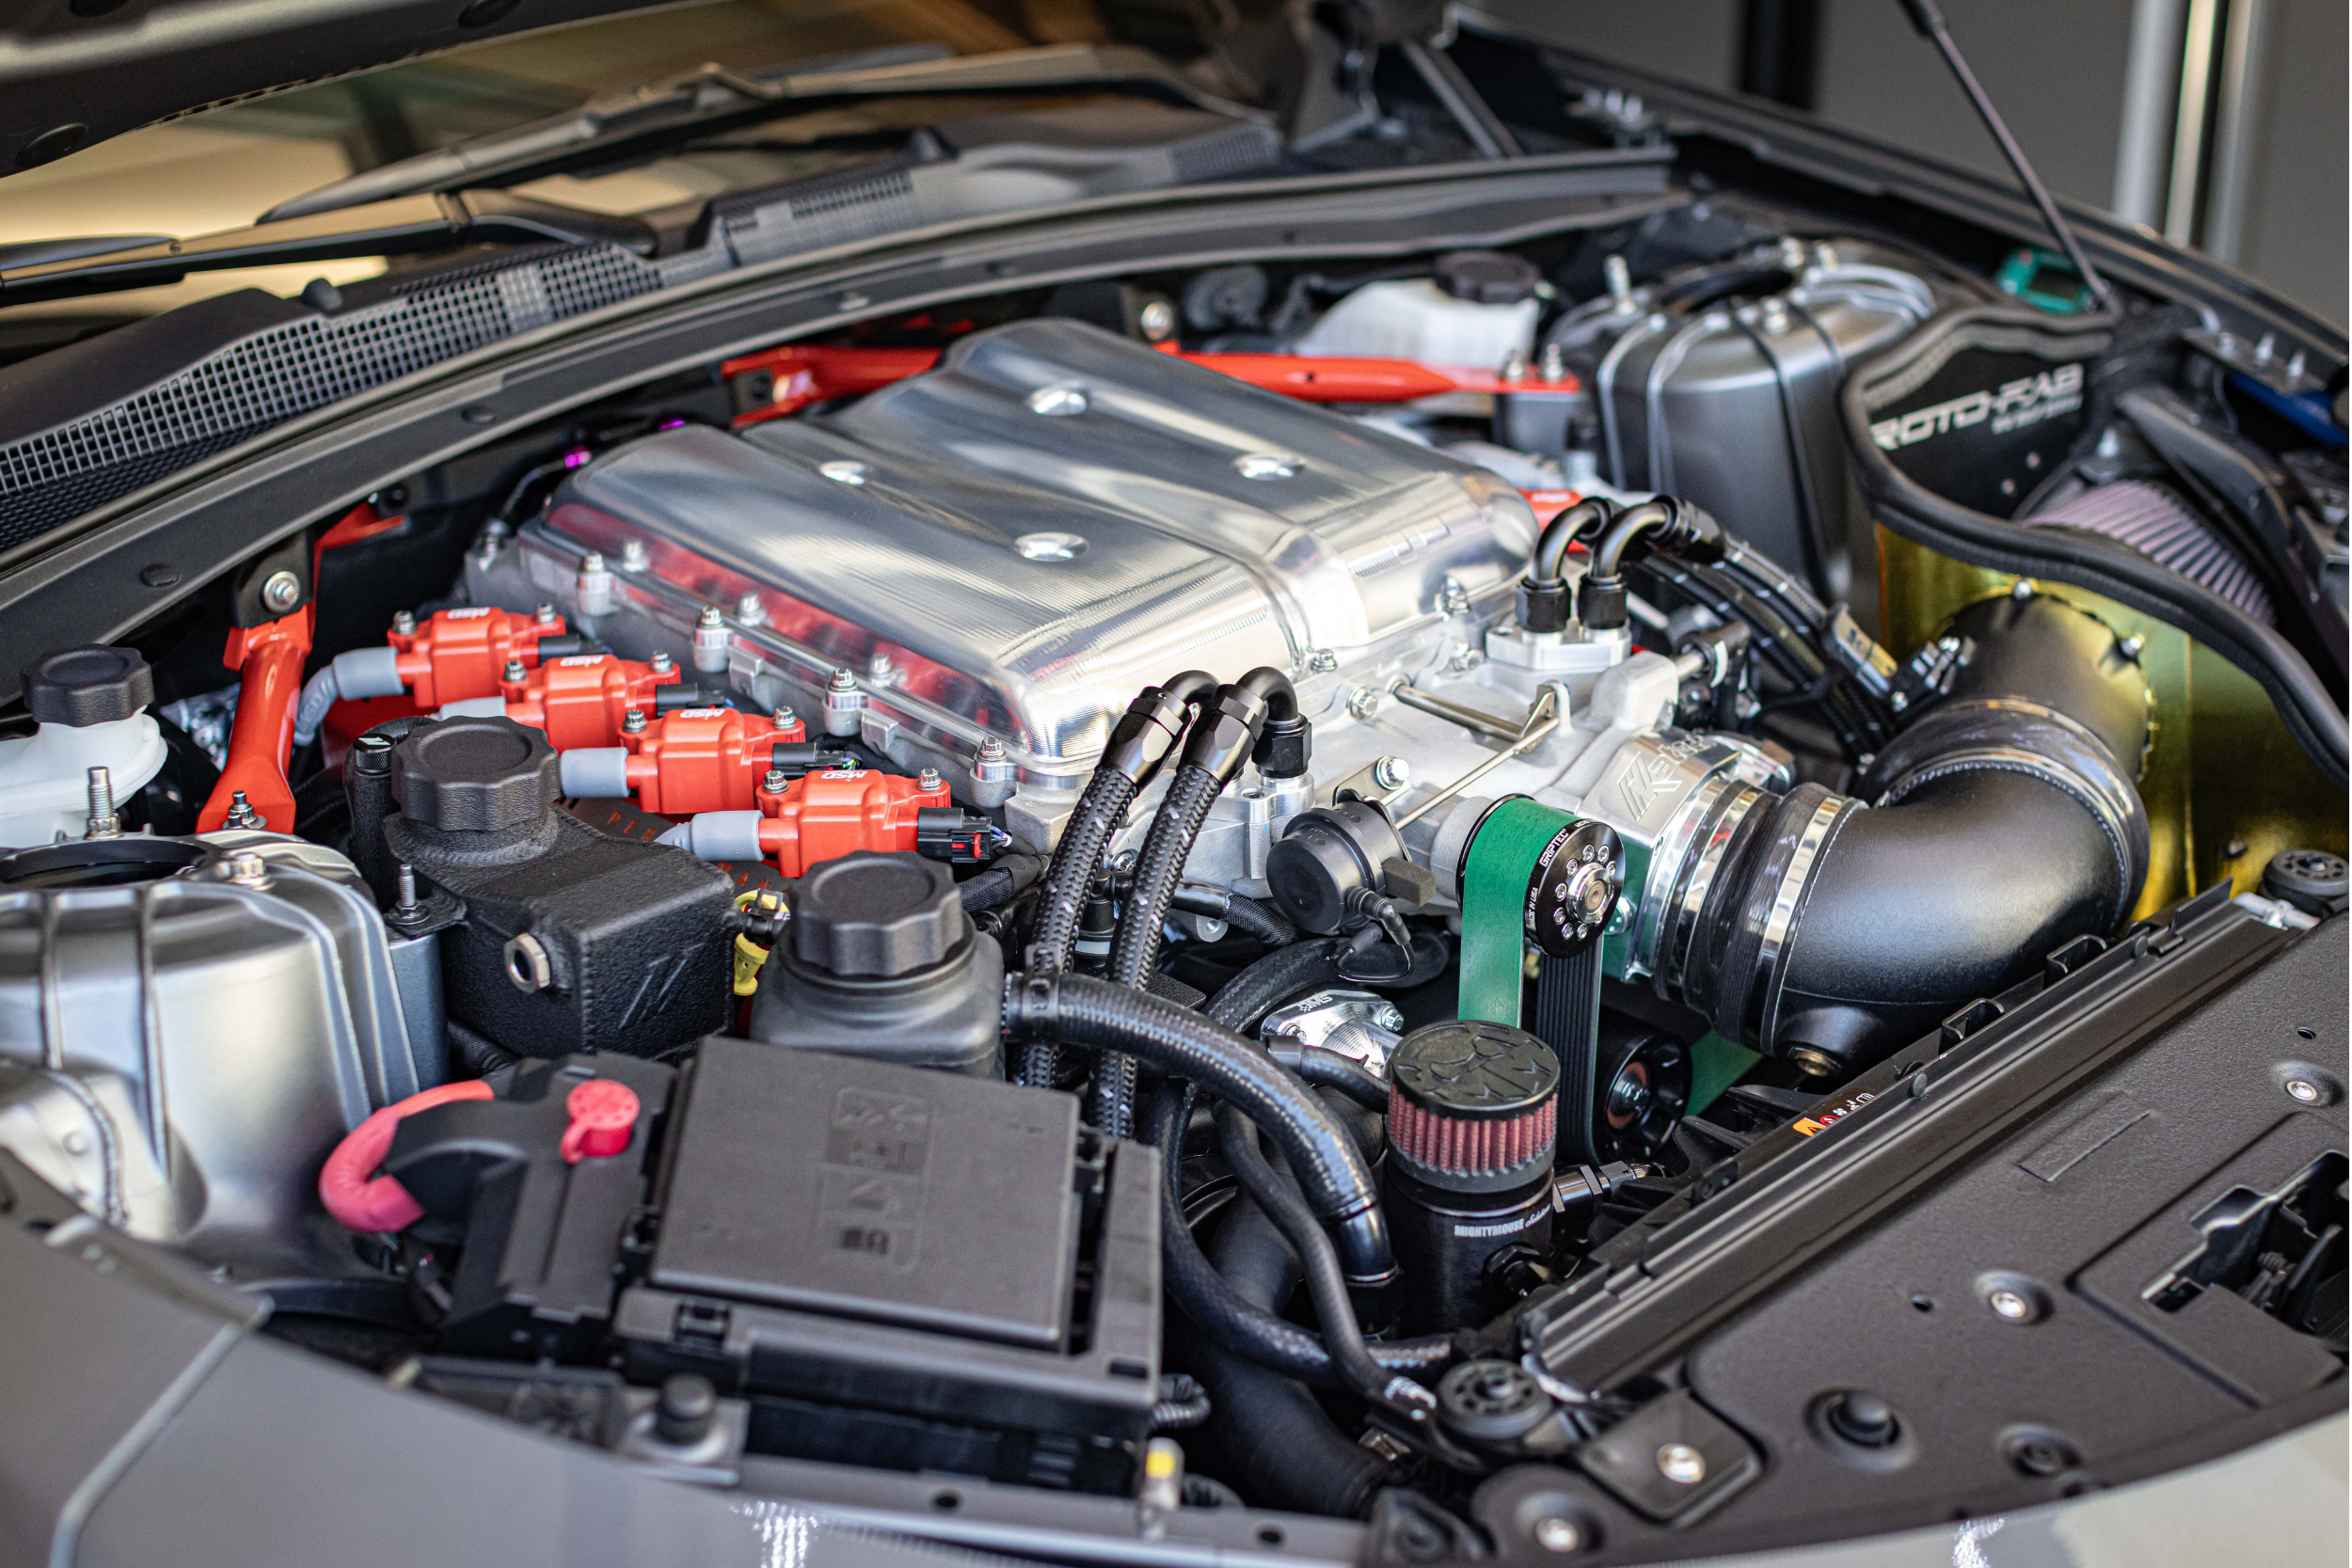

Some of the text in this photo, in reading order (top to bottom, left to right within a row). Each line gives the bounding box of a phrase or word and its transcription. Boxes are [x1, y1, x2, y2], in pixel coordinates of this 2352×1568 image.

[1869, 363, 2084, 451] ROTO-FAB
[680, 708, 725, 719] MSD
[820, 770, 867, 780] MSD
[1530, 886, 1539, 903] USA
[1529, 901, 1536, 911] IN
[1454, 1218, 1525, 1238] MIGHTYMOUSE
